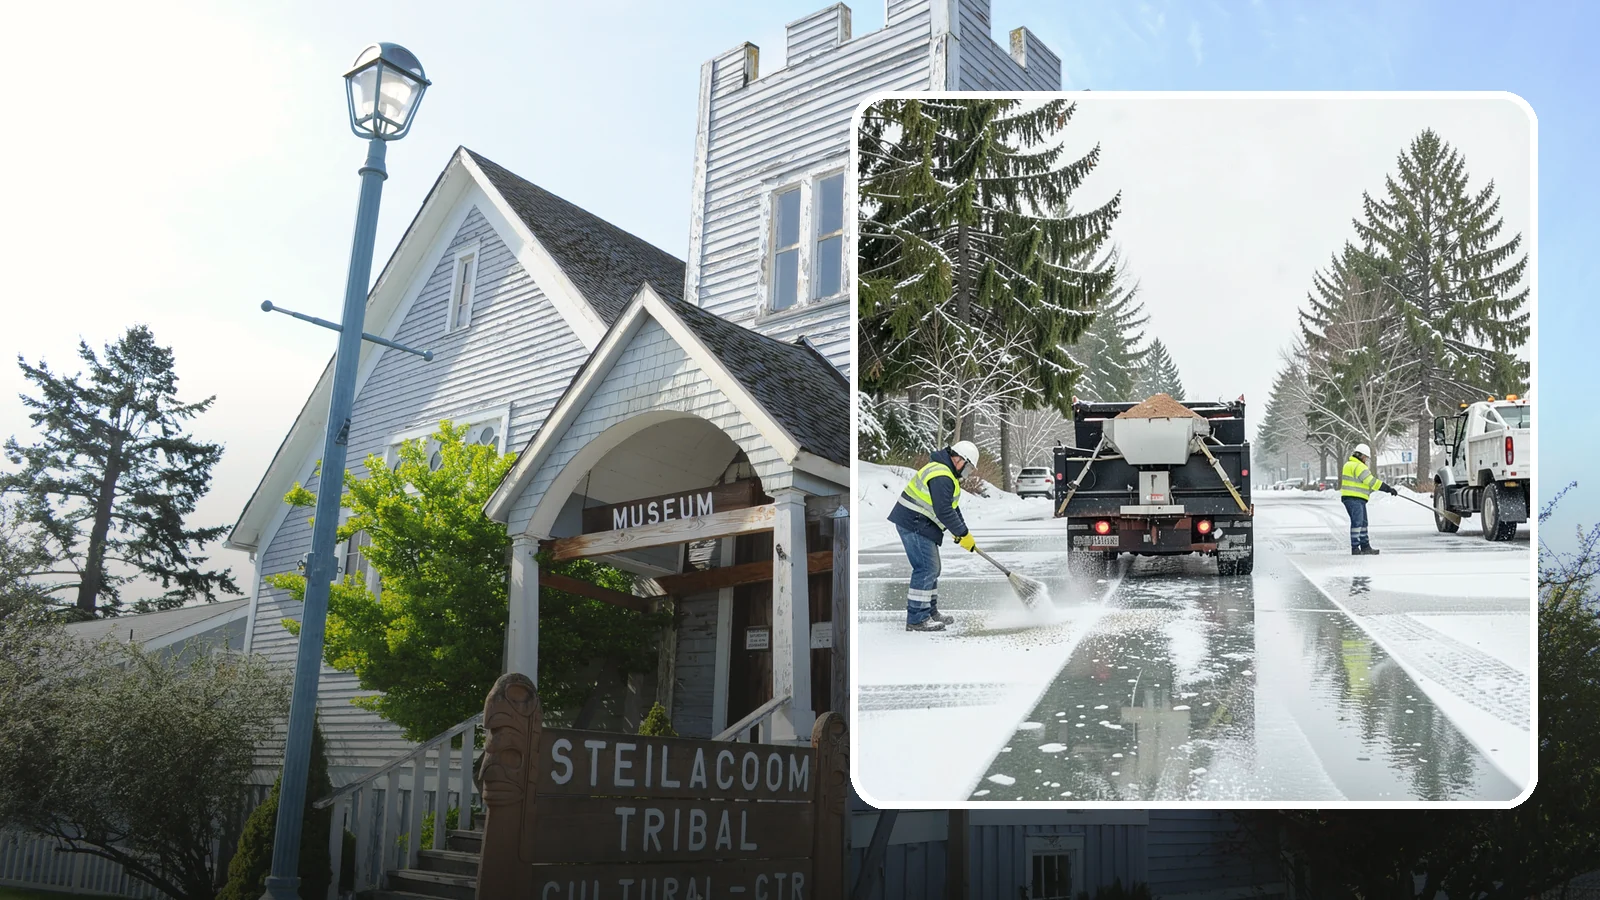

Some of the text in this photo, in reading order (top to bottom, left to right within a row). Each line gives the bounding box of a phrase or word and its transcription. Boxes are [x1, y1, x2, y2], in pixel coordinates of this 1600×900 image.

[612, 491, 714, 531] MUSEUM
[550, 738, 810, 793] STEILACOOM
[615, 806, 758, 852] TRIBAL
